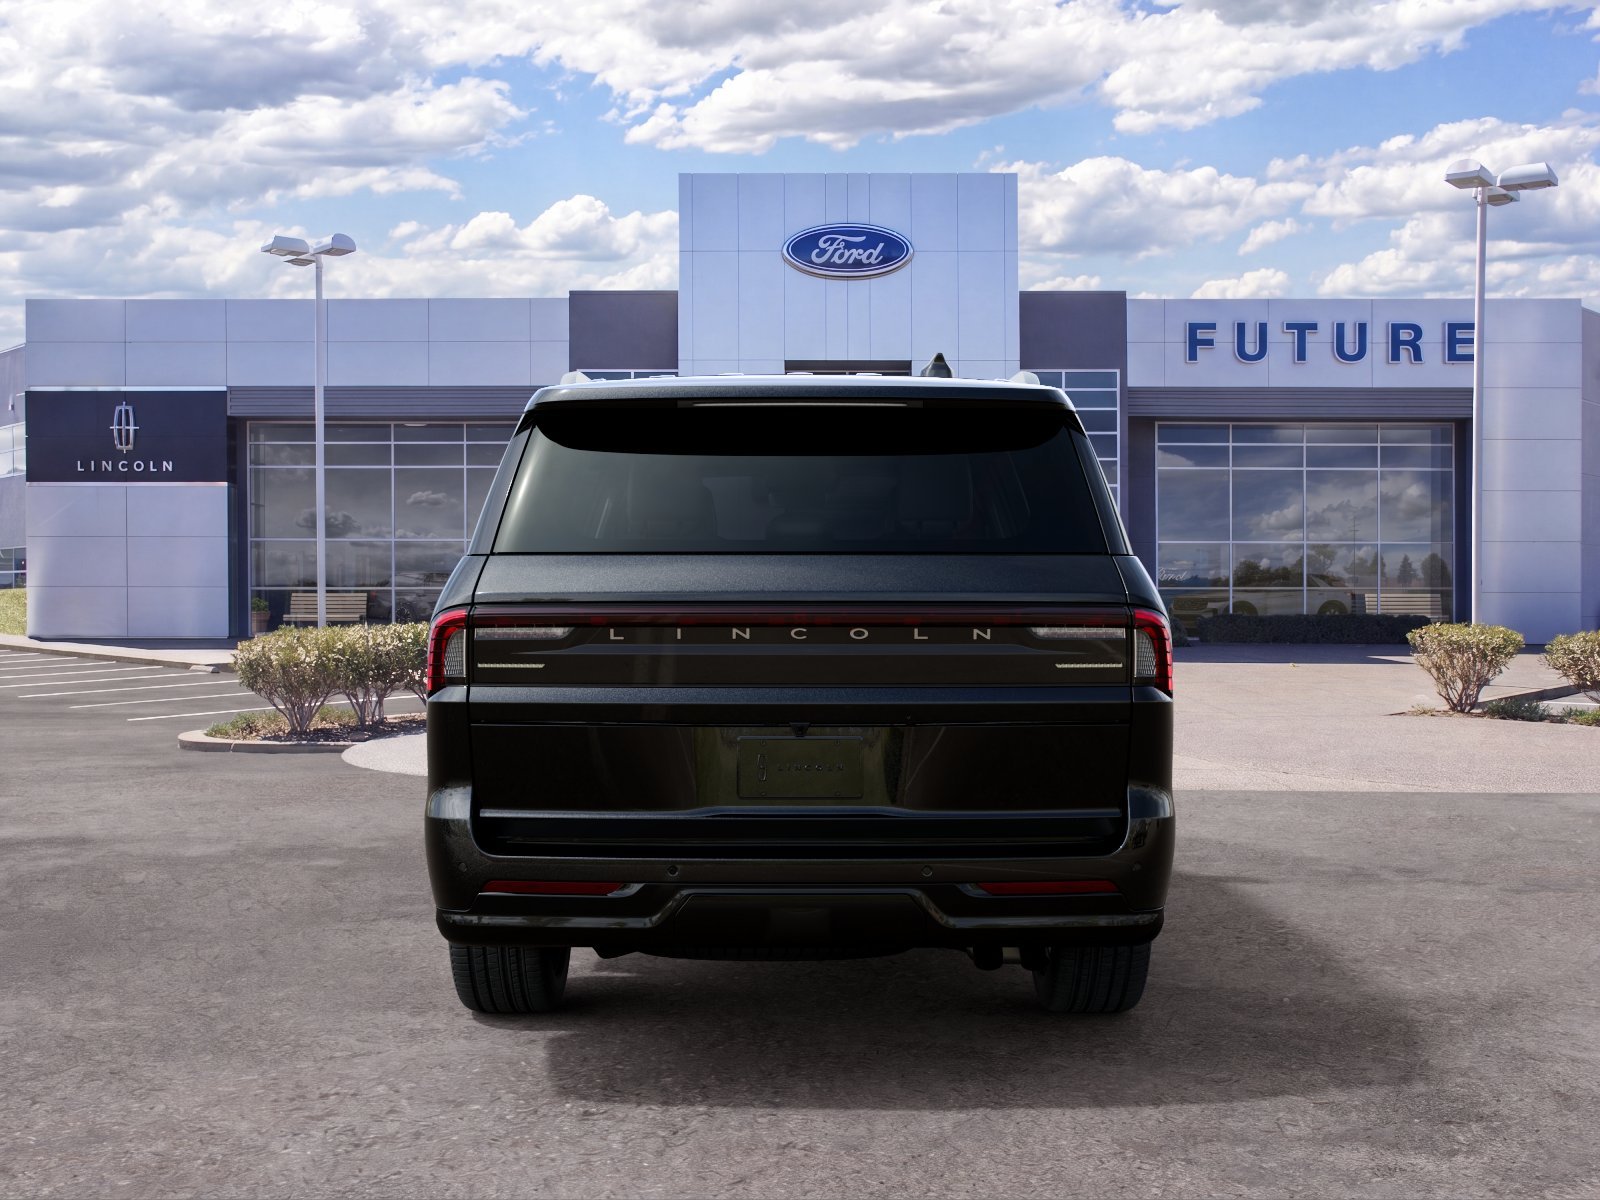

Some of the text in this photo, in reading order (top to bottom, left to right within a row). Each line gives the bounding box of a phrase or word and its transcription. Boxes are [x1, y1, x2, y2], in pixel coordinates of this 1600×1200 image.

[811, 234, 885, 264] Ford
[1185, 321, 1476, 364] FUTURE
[77, 460, 174, 472] LINCOLN
[609, 627, 992, 641] LINCOLN
